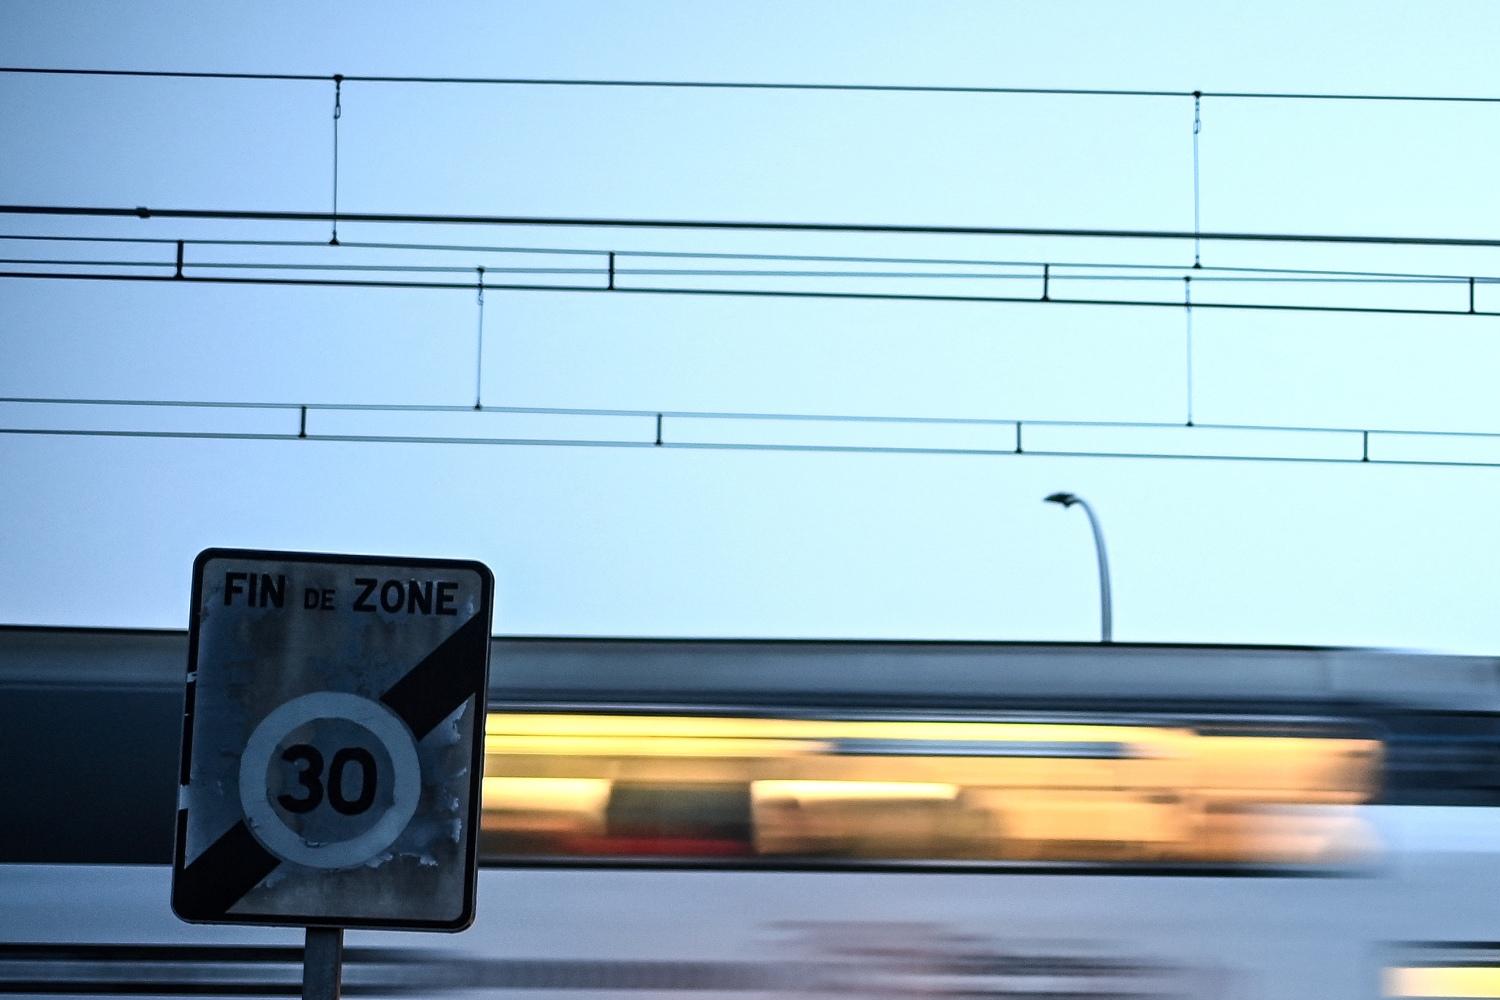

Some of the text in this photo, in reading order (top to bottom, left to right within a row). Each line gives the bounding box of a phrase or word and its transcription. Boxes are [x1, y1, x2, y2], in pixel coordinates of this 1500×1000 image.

[223, 572, 459, 616] FIN DE ZONE
[277, 743, 379, 816] 30
